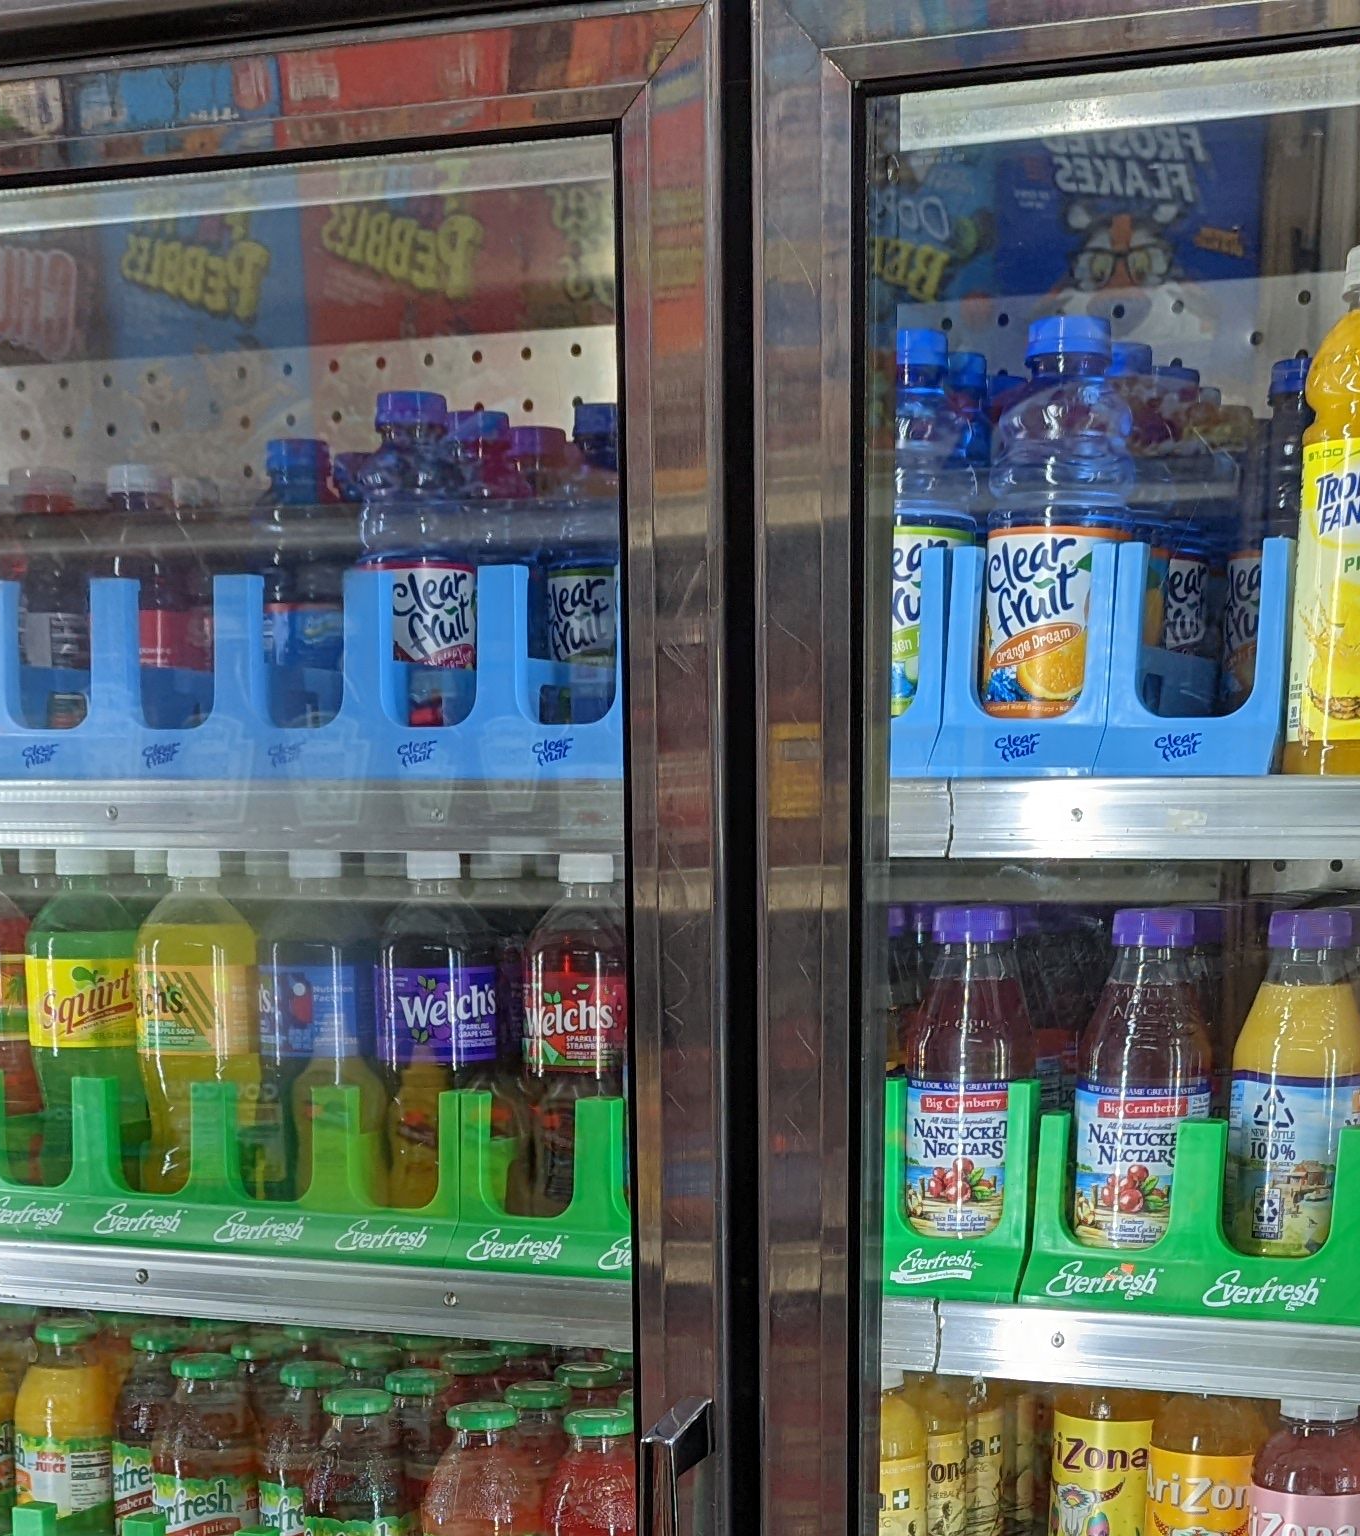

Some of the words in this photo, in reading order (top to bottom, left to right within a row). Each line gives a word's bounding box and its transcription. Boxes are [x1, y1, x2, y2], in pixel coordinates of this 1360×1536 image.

[995, 640, 1031, 665] Orange
[1032, 624, 1072, 652] Dream
[41, 969, 131, 1037] Squirt
[399, 984, 497, 1028] Welch's
[524, 1001, 614, 1040] Welch's
[922, 1095, 943, 1111] Big
[943, 1094, 1002, 1111] Cranberry
[1103, 1100, 1121, 1115] Big
[1123, 1098, 1182, 1117] Cranberry
[913, 1117, 1008, 1141] NANTUCKET
[922, 1137, 1004, 1160] NECTARS
[1250, 1141, 1296, 1162] 100%
[93, 1207, 183, 1238] Everfresh
[213, 1212, 306, 1243] Everfresh
[335, 1220, 428, 1250] Everfresh
[467, 1228, 563, 1258] Everfresh
[1046, 1261, 1159, 1297] Everfresh
[1203, 1270, 1320, 1307] Everfresh
